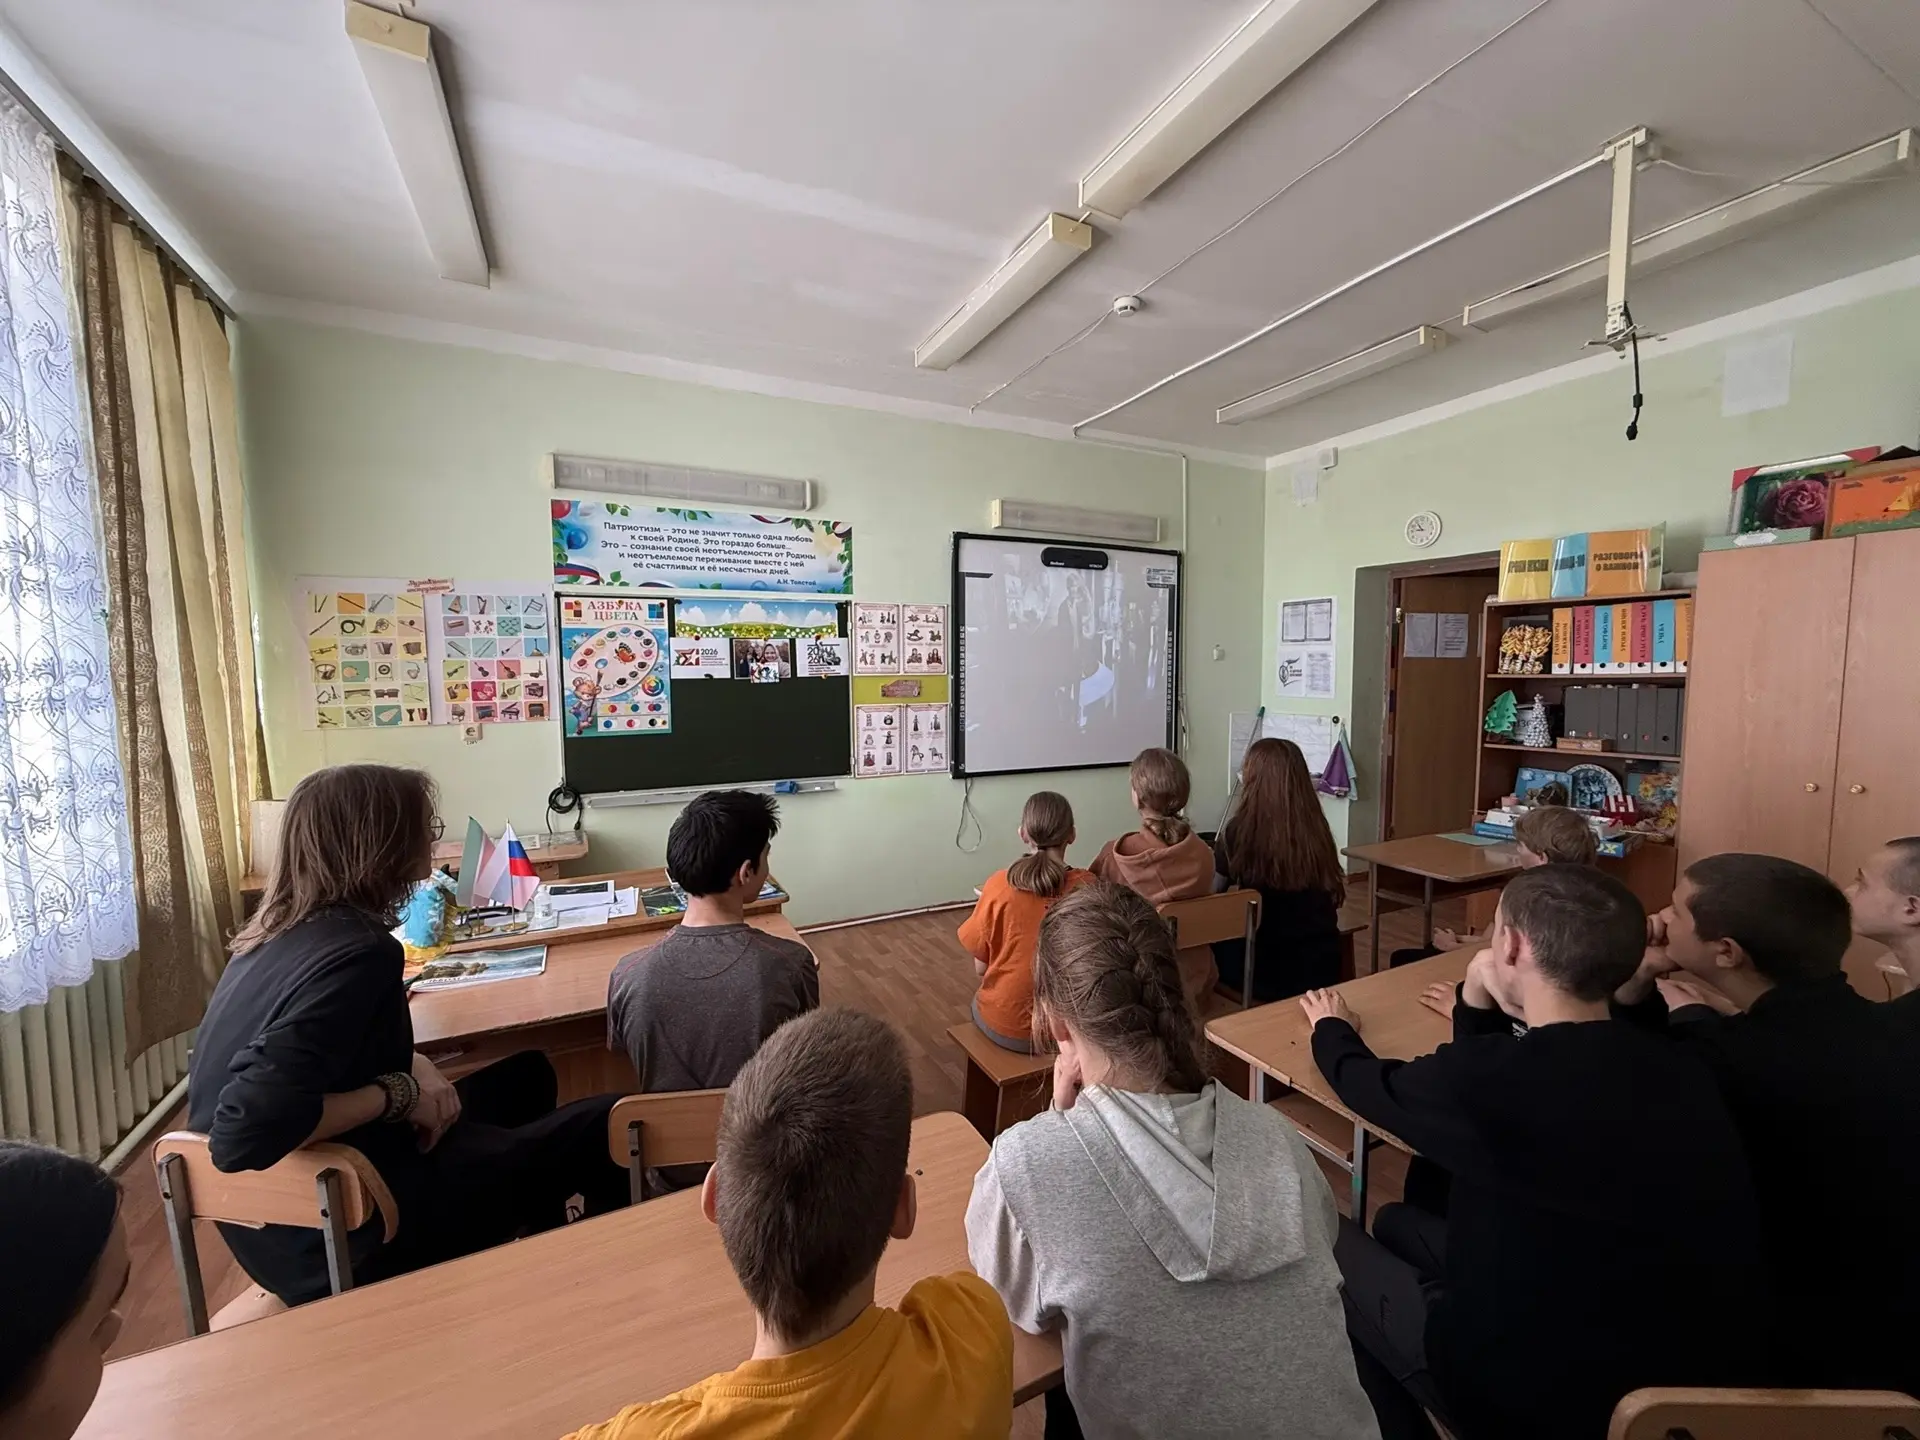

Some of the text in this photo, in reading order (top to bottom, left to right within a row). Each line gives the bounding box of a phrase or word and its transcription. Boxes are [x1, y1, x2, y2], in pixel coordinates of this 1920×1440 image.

[604, 522, 661, 533] Патриотизм
[672, 527, 686, 535] это
[732, 531, 761, 540] только
[763, 533, 782, 541] одна
[784, 534, 813, 543] любовь
[638, 534, 665, 543] своей
[667, 535, 701, 545] Родине.
[703, 538, 720, 546] Это
[721, 540, 755, 549] гораздо
[601, 540, 619, 549] Это
[630, 543, 673, 552] сознание
[674, 545, 700, 553] своей
[702, 547, 773, 558] неотъемлемости
[786, 551, 817, 560] Родины
[627, 552, 693, 562] неотъемлемое
[695, 556, 752, 565] переживание
[754, 558, 782, 567] вместе
[790, 559, 805, 567] ней
[1593, 551, 1644, 562] РАЗГОВОРЫ
[646, 562, 698, 571] счастливых
[719, 565, 767, 575] несчастных
[769, 568, 791, 576] дней.
[1596, 562, 1639, 572] О ВАЖНОМ
[587, 601, 643, 611] АЗБУКА
[594, 611, 639, 621] ЦВЕТА
[807, 646, 819, 656] 20
[807, 655, 820, 664] 26
